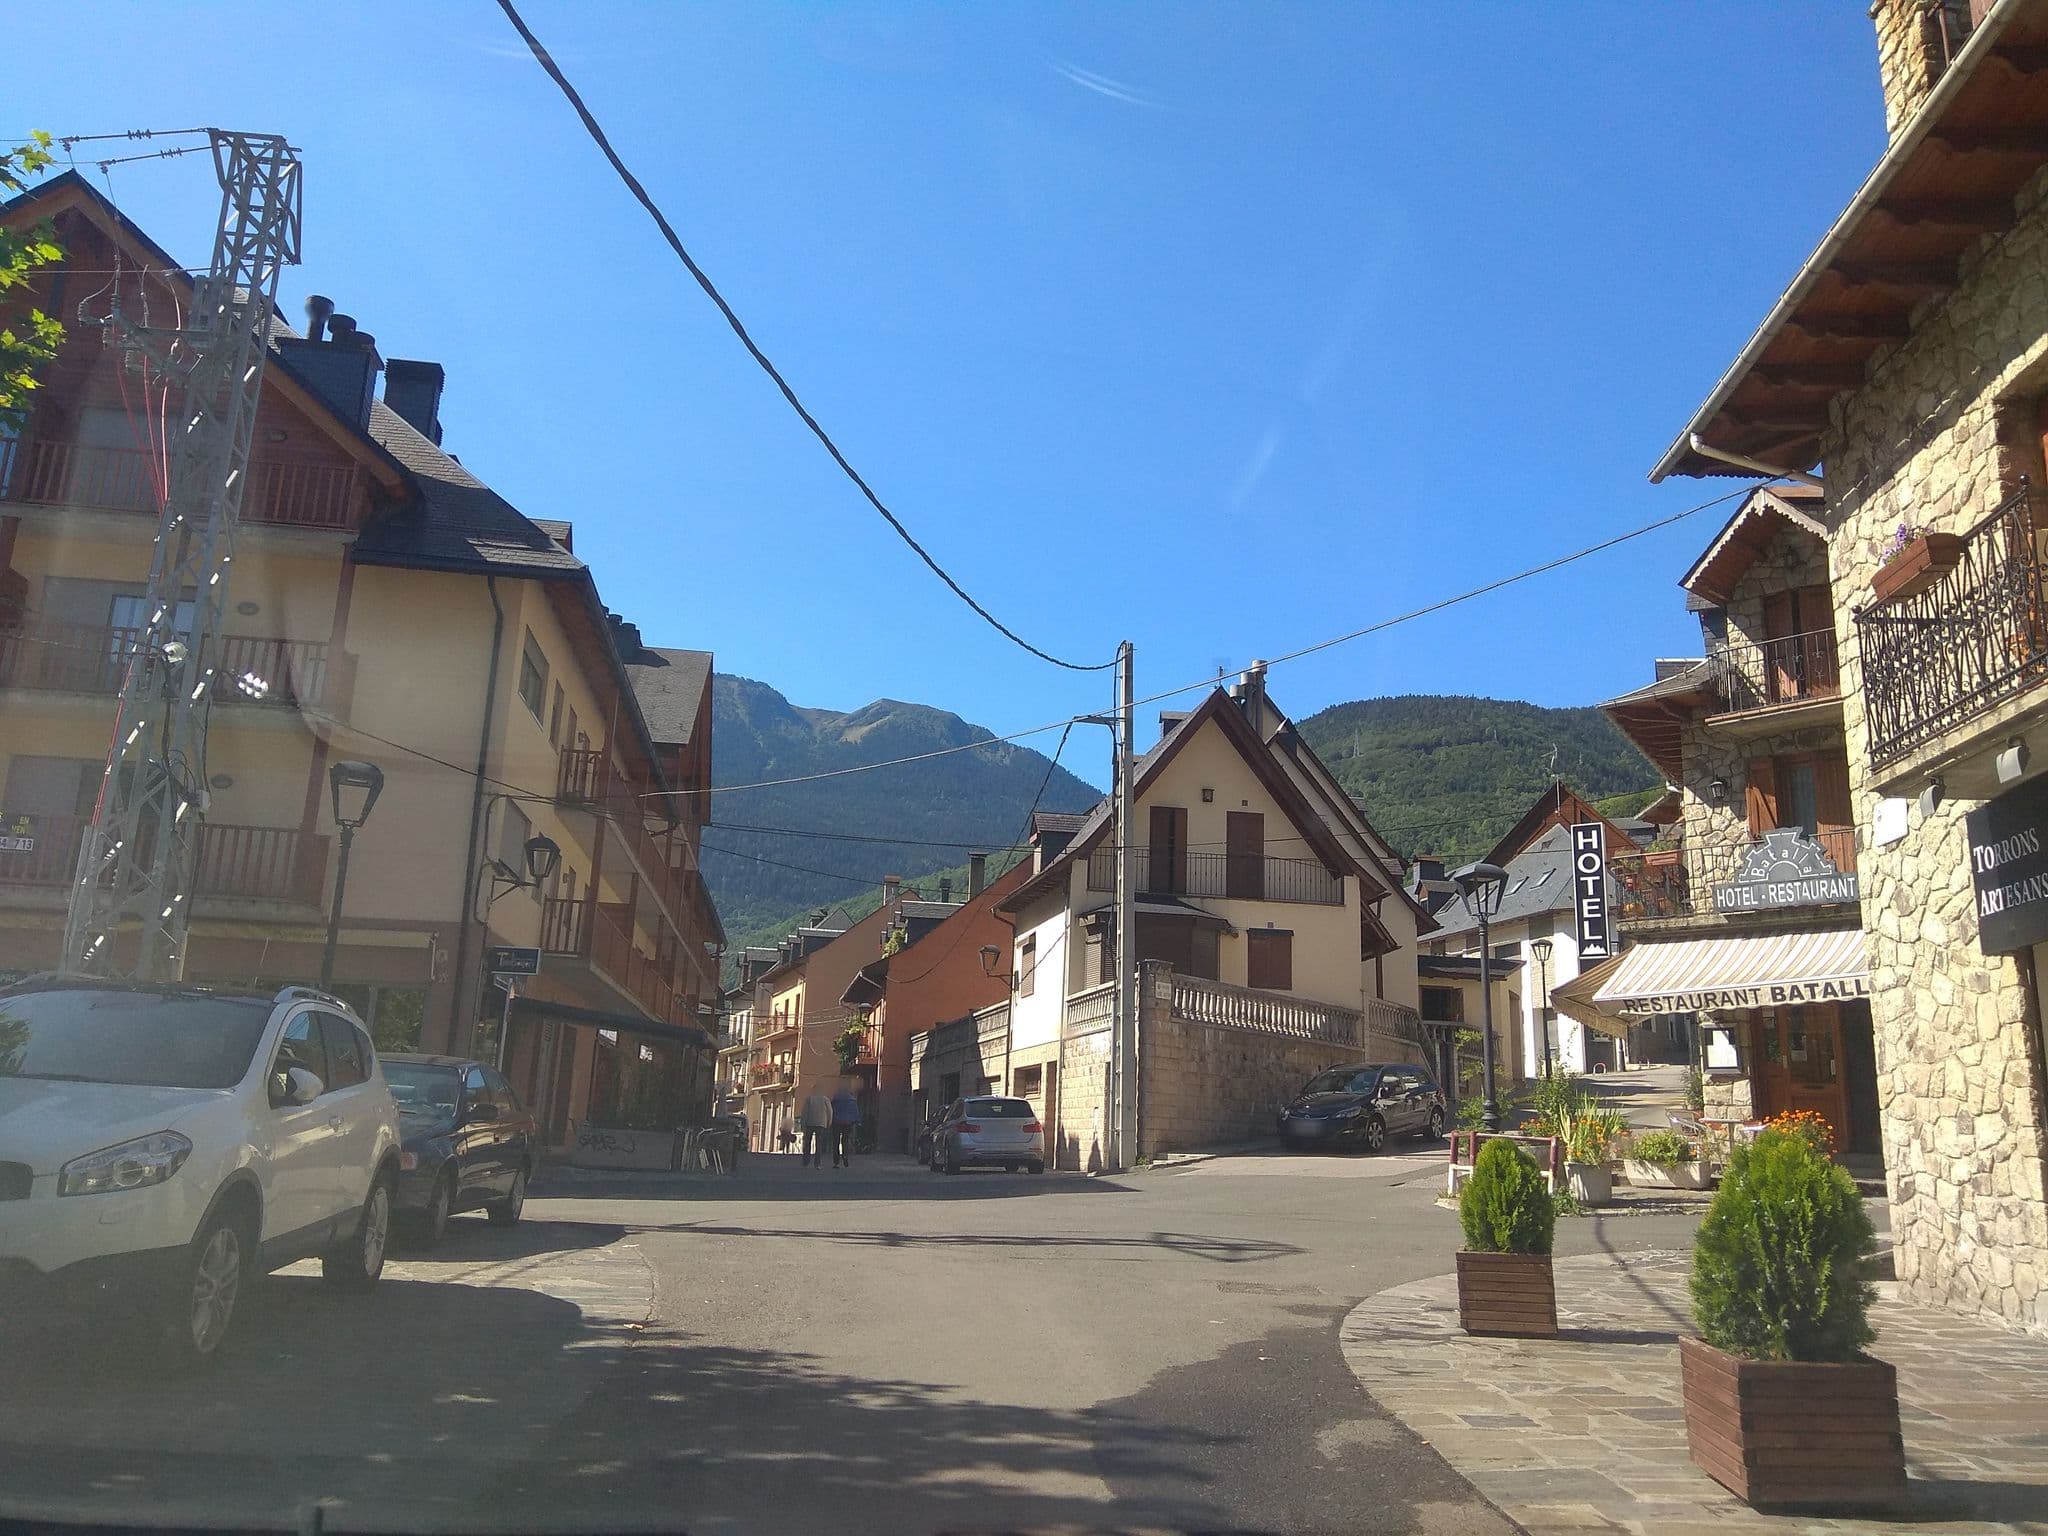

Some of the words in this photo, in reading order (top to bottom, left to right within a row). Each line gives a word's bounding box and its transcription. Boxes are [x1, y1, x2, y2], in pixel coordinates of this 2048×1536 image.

[1750, 847, 1812, 878] Batalla
[1973, 827, 2040, 873] TORRONS
[1577, 829, 1603, 940] HOTEL
[1716, 886, 1759, 908] HOTEL
[1768, 877, 1856, 904] RESTAURANT
[1980, 872, 2048, 917] ARTESANS
[1623, 987, 1762, 1014] RESTAURANT
